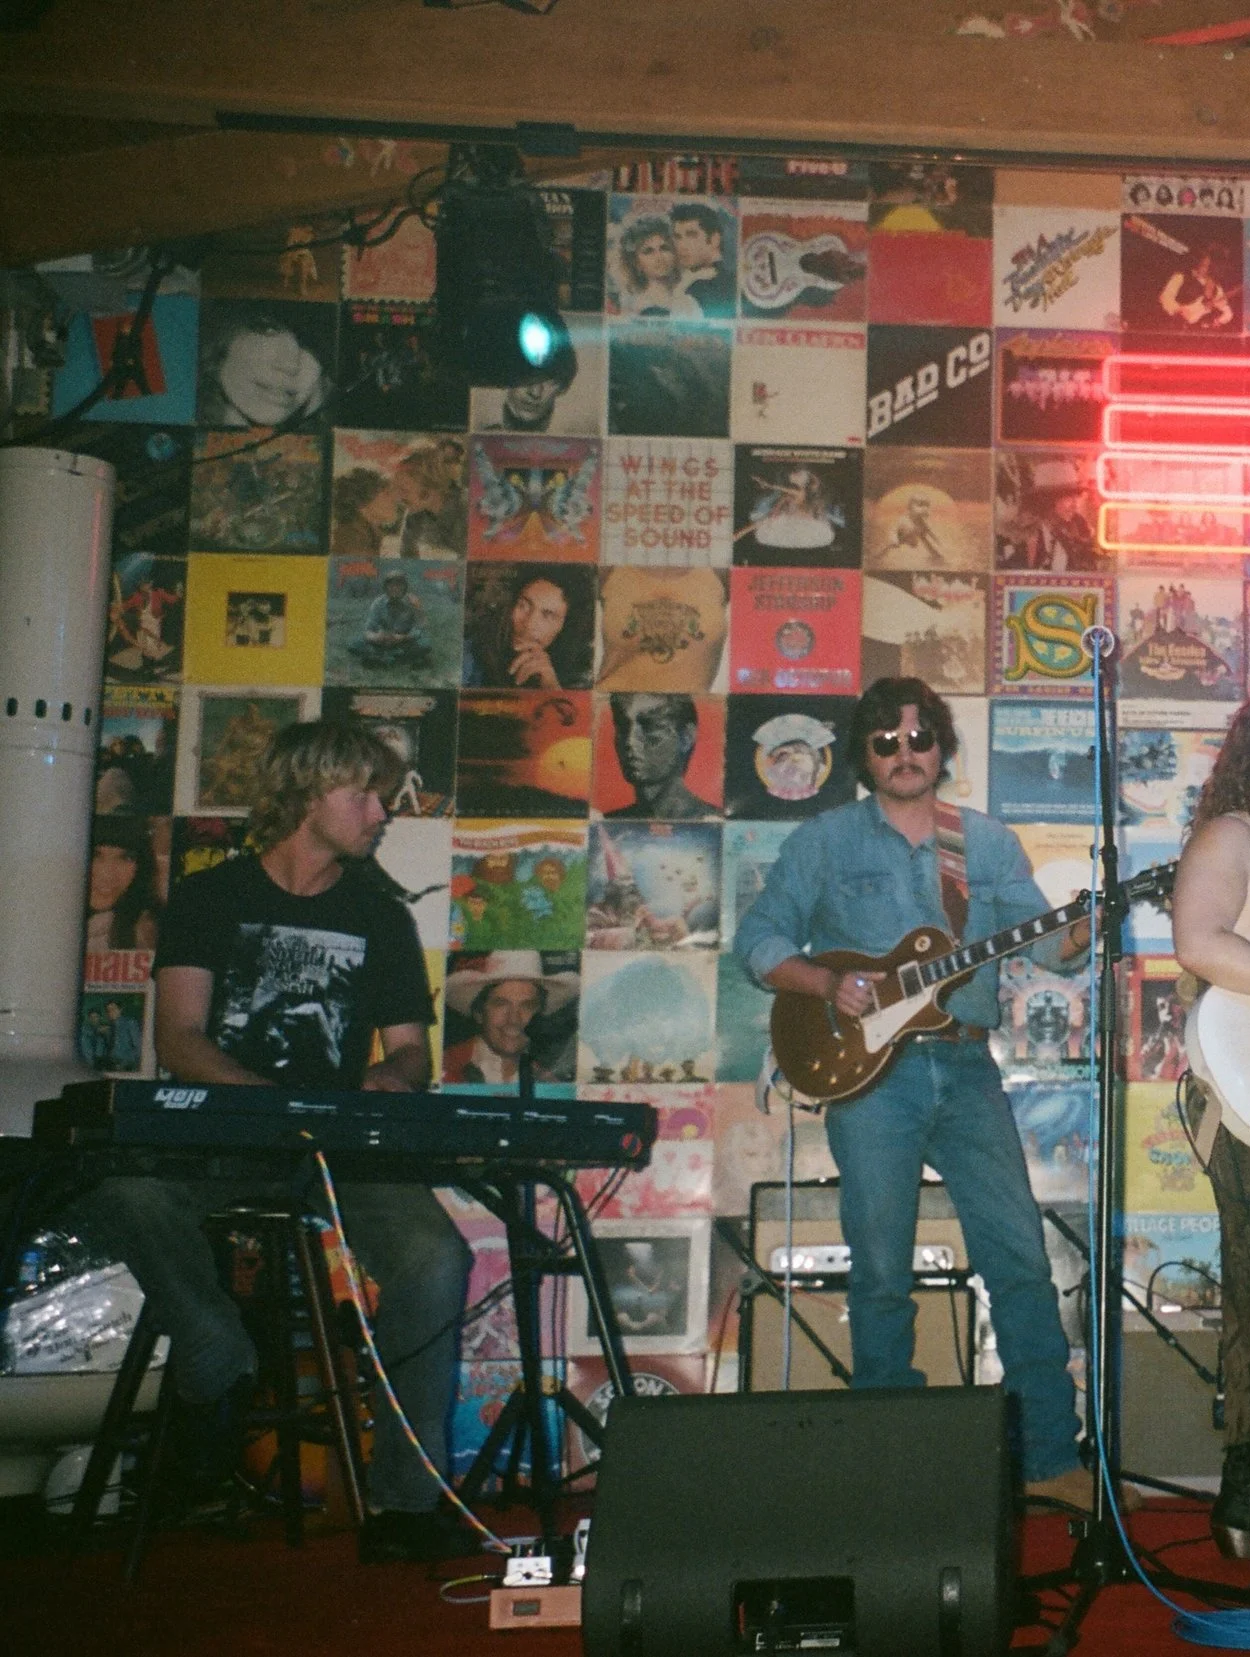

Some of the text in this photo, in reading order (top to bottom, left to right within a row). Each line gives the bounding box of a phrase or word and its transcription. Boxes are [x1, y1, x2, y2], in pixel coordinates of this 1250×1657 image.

[867, 362, 938, 438] BAD
[944, 332, 989, 388] CO
[620, 455, 720, 478] WINGS
[627, 479, 710, 502] AT THE
[605, 503, 730, 526] SPEED OF
[622, 528, 711, 549] SOUND
